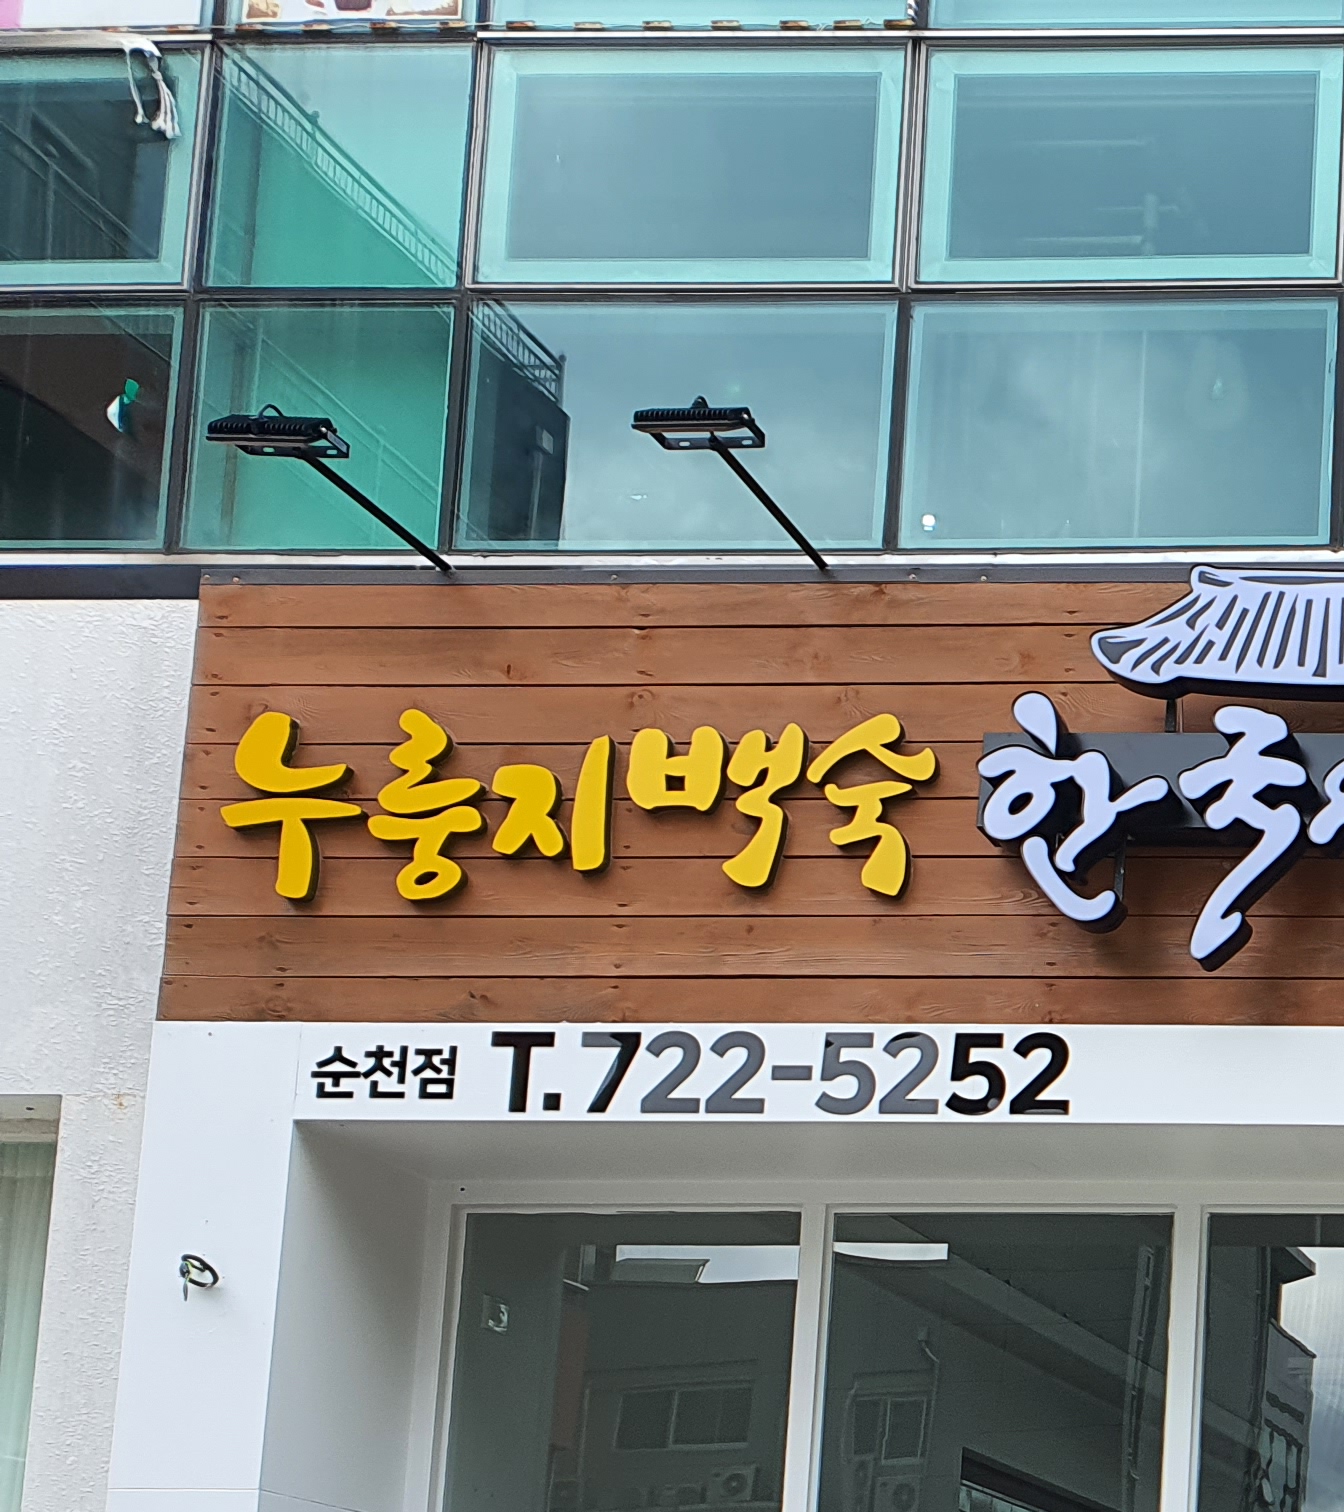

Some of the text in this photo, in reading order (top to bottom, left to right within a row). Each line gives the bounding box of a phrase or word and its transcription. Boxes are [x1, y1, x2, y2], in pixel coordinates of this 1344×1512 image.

[219, 708, 937, 900] 누룽지백숙
[311, 1031, 1071, 1116] 순천점 T.722-5252
